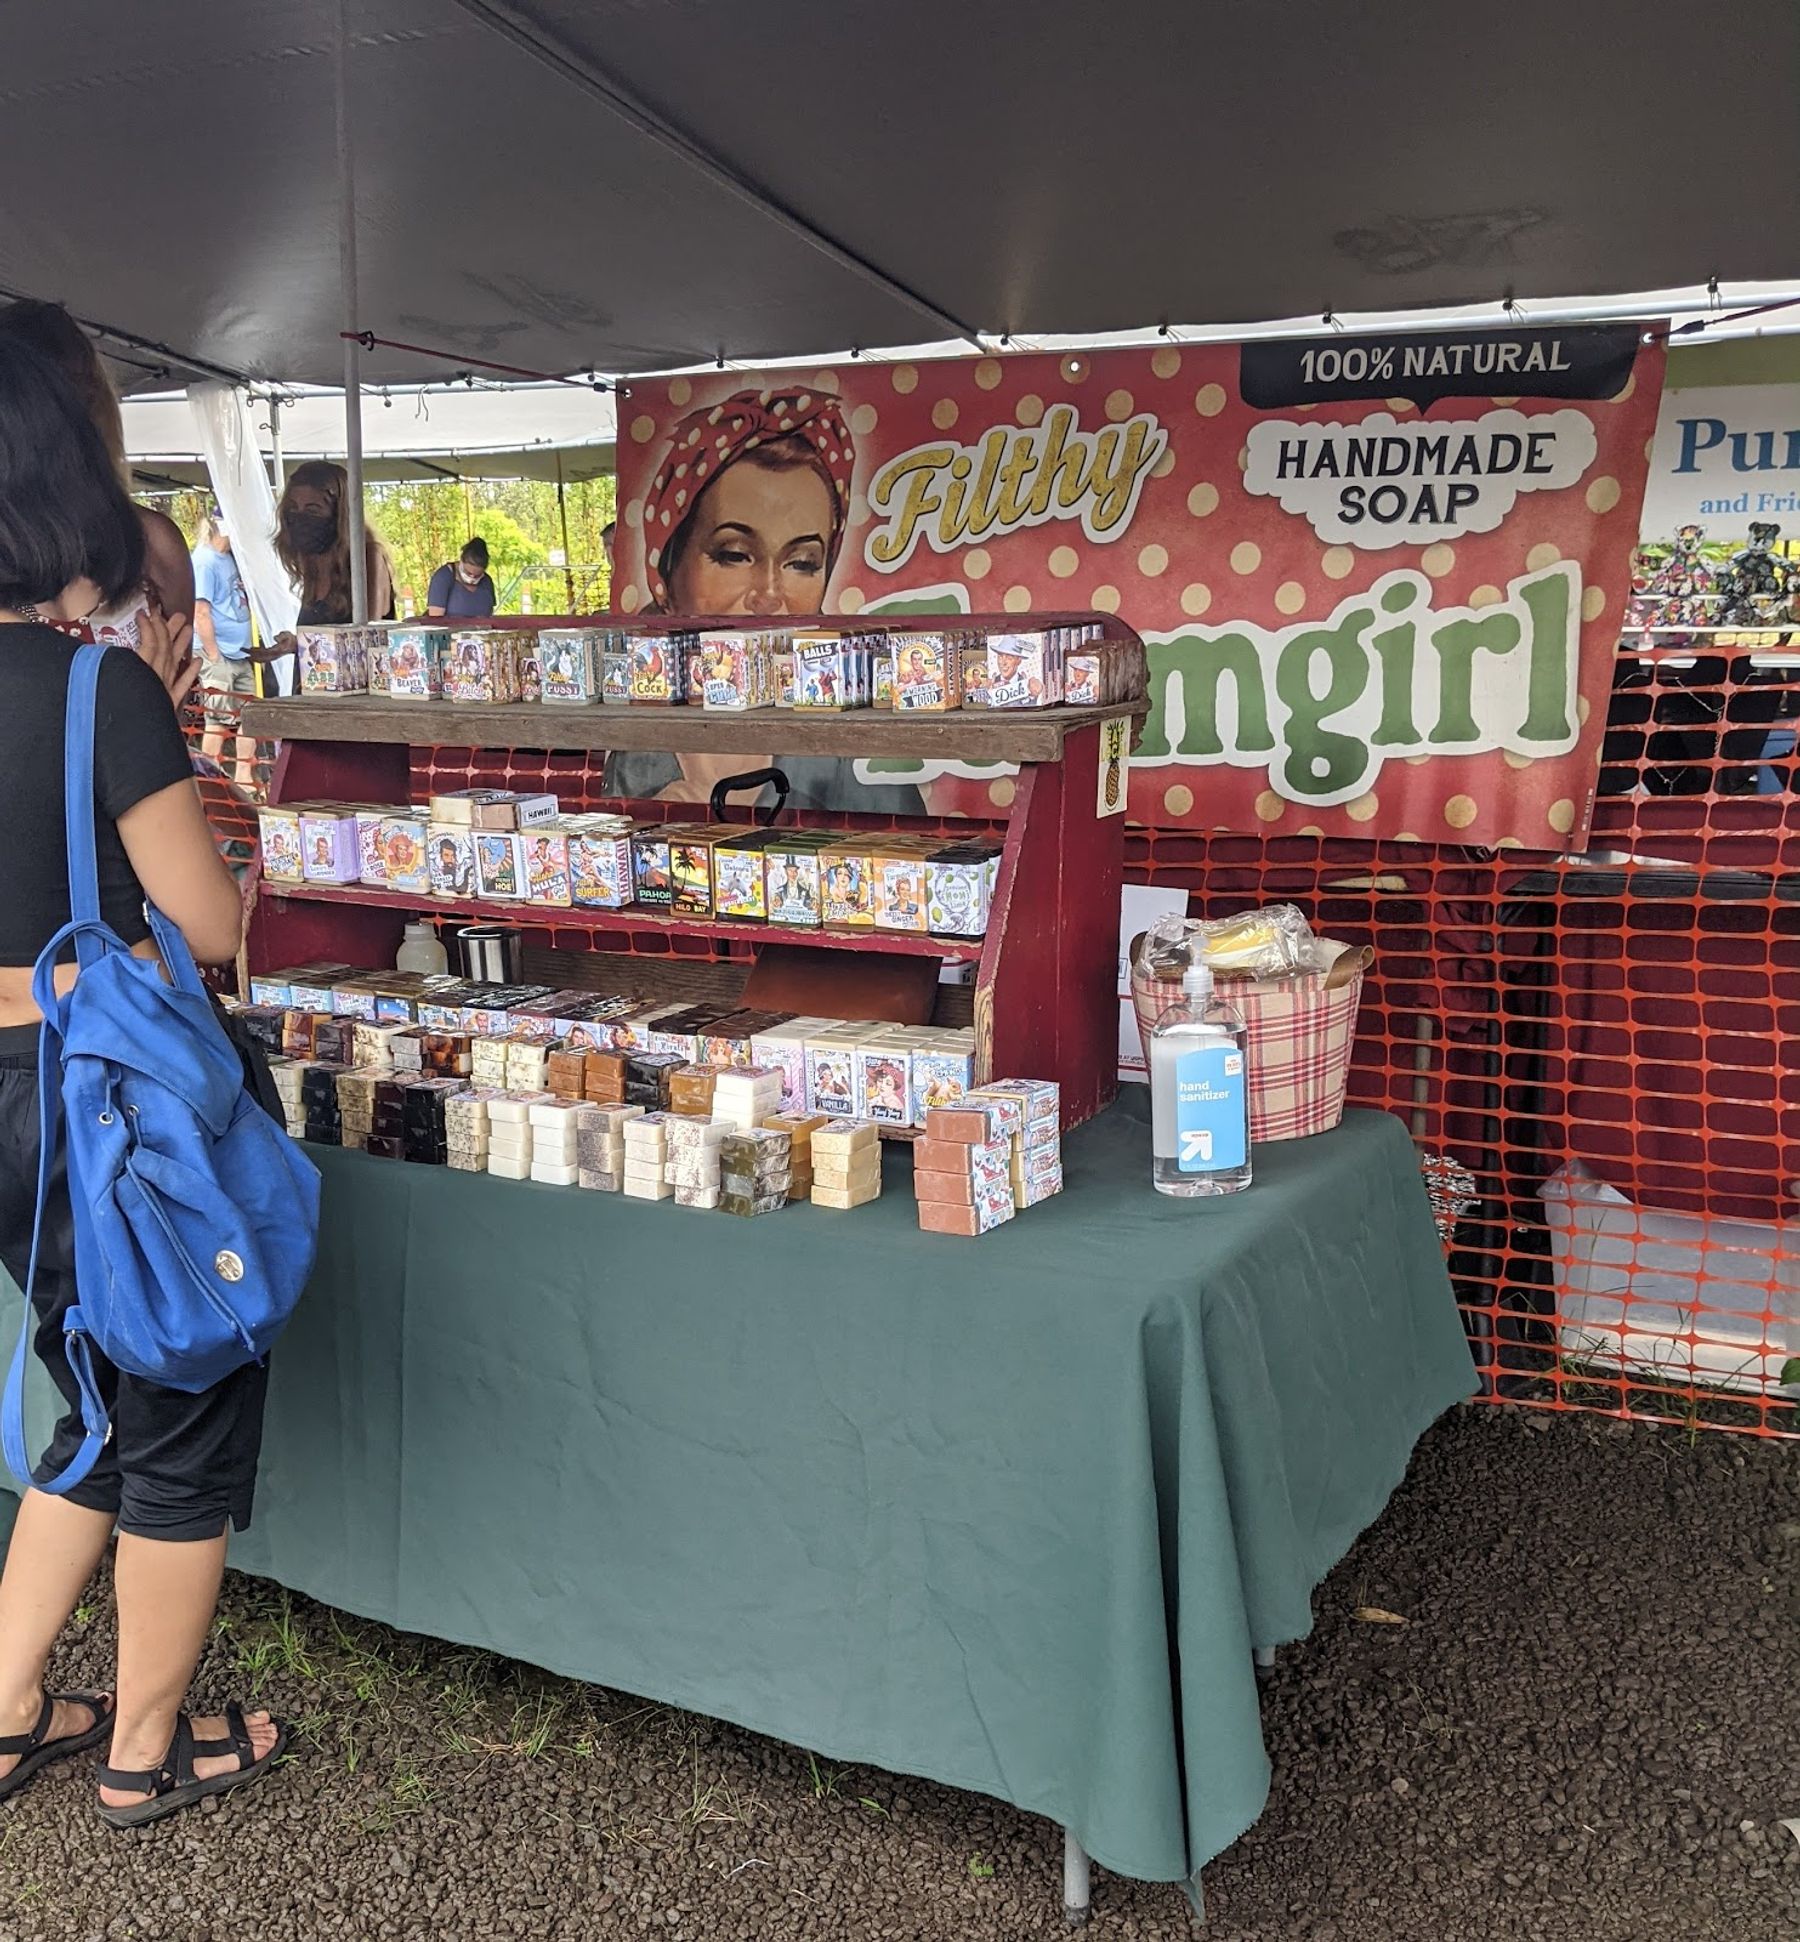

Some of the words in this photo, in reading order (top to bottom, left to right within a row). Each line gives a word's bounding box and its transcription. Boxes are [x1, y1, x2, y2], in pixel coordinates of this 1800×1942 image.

[1302, 348, 1393, 383] 100%
[1402, 341, 1571, 377] NATURAL
[1276, 432, 1557, 479] HANDMADE
[872, 406, 1163, 563] Filthy
[1337, 483, 1480, 524] SOAP
[1700, 492, 1749, 514] and
[803, 644, 833, 659] BALLS
[547, 685, 579, 695] PUSSY
[995, 681, 1026, 704] Dick
[1071, 688, 1091, 702] Dick
[911, 691, 938, 706] WOOD
[617, 840, 630, 897] HAWAII
[495, 882, 512, 891] HOE
[533, 870, 566, 892] HULA
[575, 887, 609, 898] SURFER
[694, 904, 707, 913] BAY
[1180, 1080, 1209, 1092] hand
[1179, 1090, 1230, 1103] sanitizer
